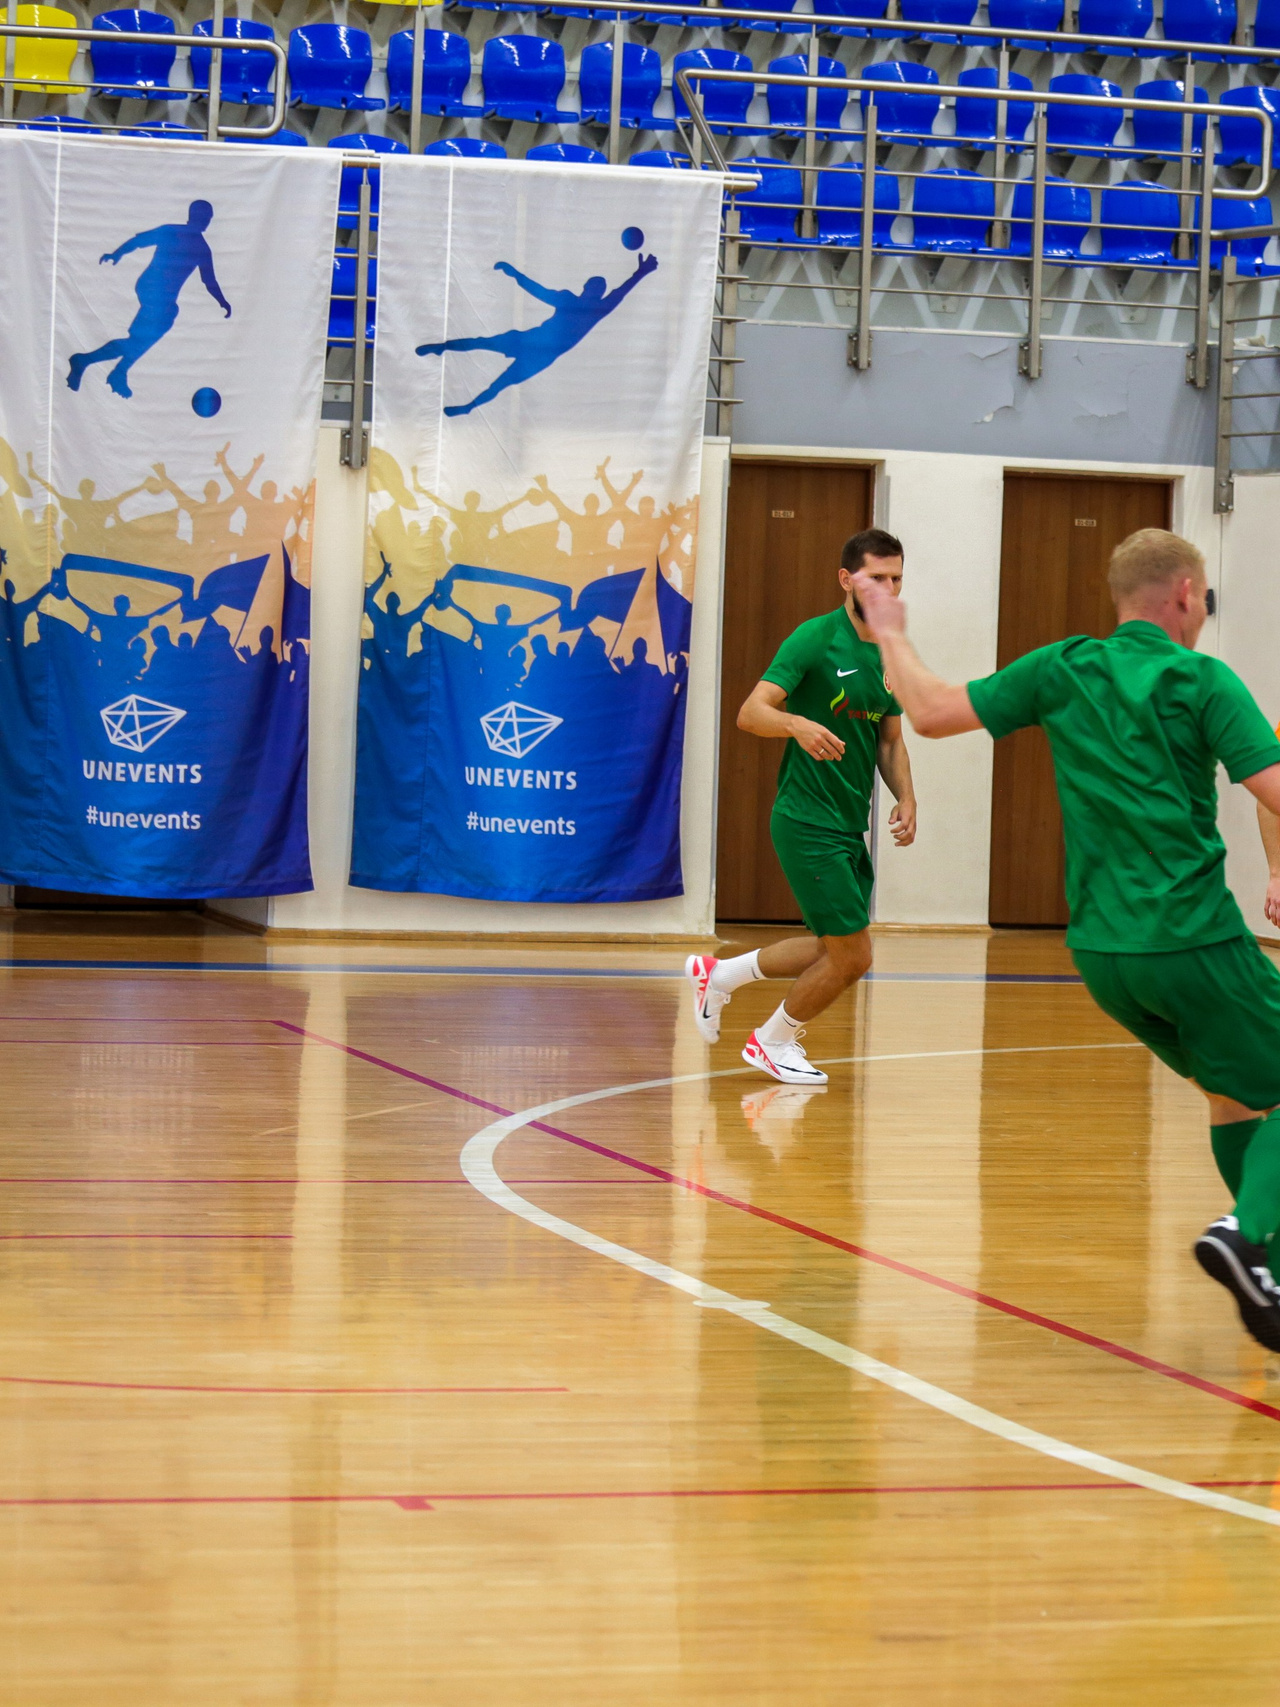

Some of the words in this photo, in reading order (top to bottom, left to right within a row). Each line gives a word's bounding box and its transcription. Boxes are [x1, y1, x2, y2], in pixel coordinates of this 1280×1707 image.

[82, 759, 202, 784] UNEVENTS
[464, 766, 577, 791] UNEVENTS
[86, 804, 201, 830] #unevents
[466, 810, 576, 836] #unevents
